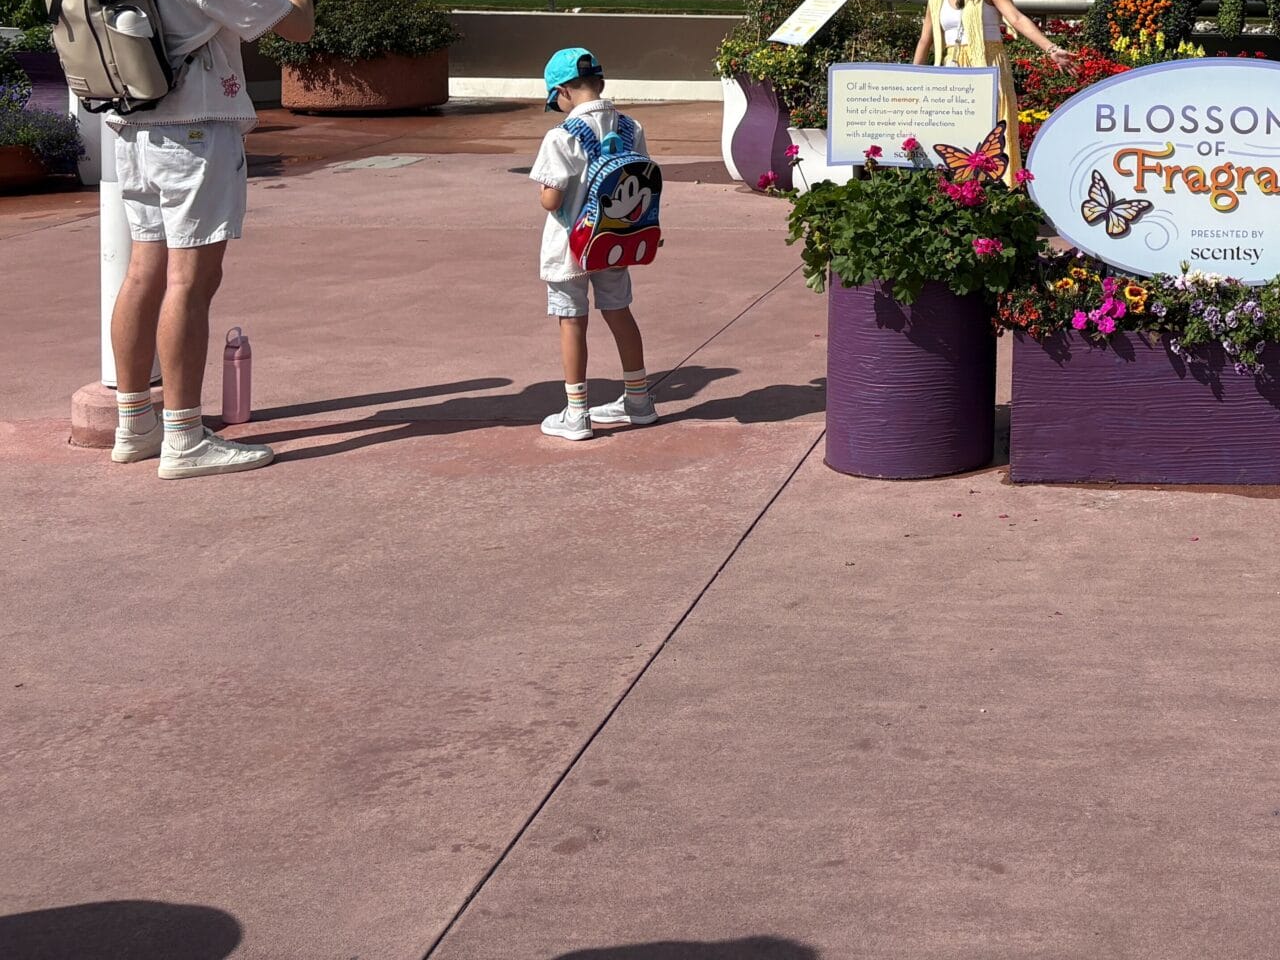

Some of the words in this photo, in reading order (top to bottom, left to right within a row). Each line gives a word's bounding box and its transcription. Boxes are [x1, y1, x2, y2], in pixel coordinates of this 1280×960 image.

[846, 82, 858, 90] Of
[867, 82, 880, 91] five
[949, 84, 975, 94] strongly
[846, 95, 882, 103] connected
[946, 95, 955, 104] of
[846, 106, 859, 114] hint
[860, 106, 868, 114] of
[920, 106, 951, 117] fragrance
[951, 107, 963, 115] has
[876, 118, 897, 126] evoke
[914, 119, 956, 127] recollections
[846, 130, 861, 138] with
[862, 132, 896, 140] staggering
[1197, 141, 1226, 156] OF
[1191, 229, 1248, 239] PRESENTED
[1250, 229, 1265, 239] BY
[1190, 245, 1265, 265] scentsy
